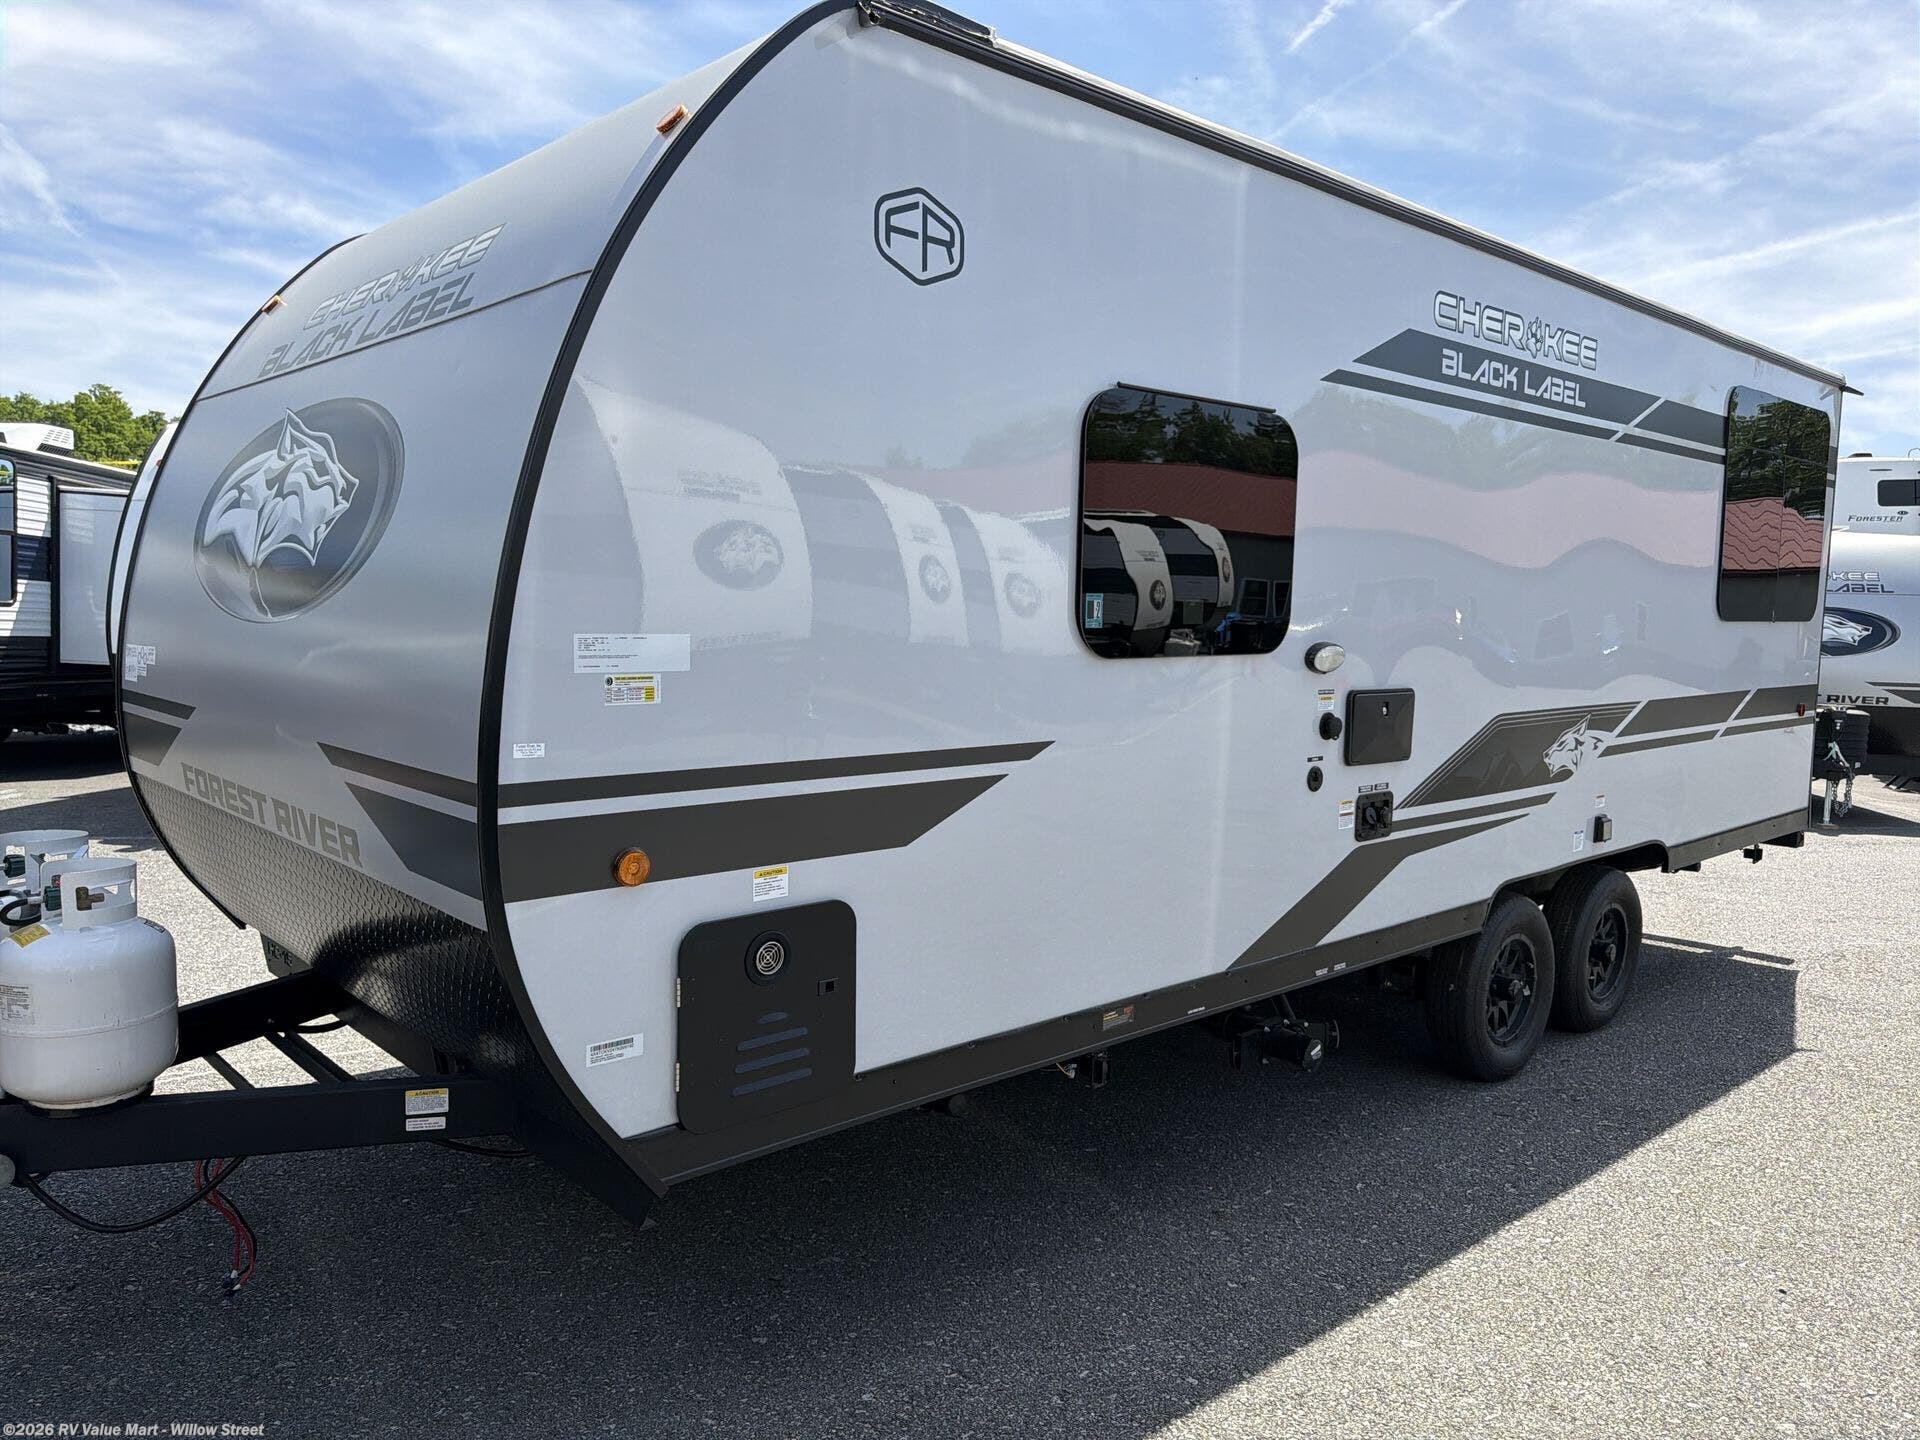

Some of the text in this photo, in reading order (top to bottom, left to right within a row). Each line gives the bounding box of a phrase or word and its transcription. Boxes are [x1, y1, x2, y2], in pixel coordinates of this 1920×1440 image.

[257, 272, 475, 379] BLACK LABEL
[1441, 347, 1587, 408] BLACK LABEL
[1826, 694, 1889, 705] RIVER
[181, 761, 363, 868] FOREST RIVER
